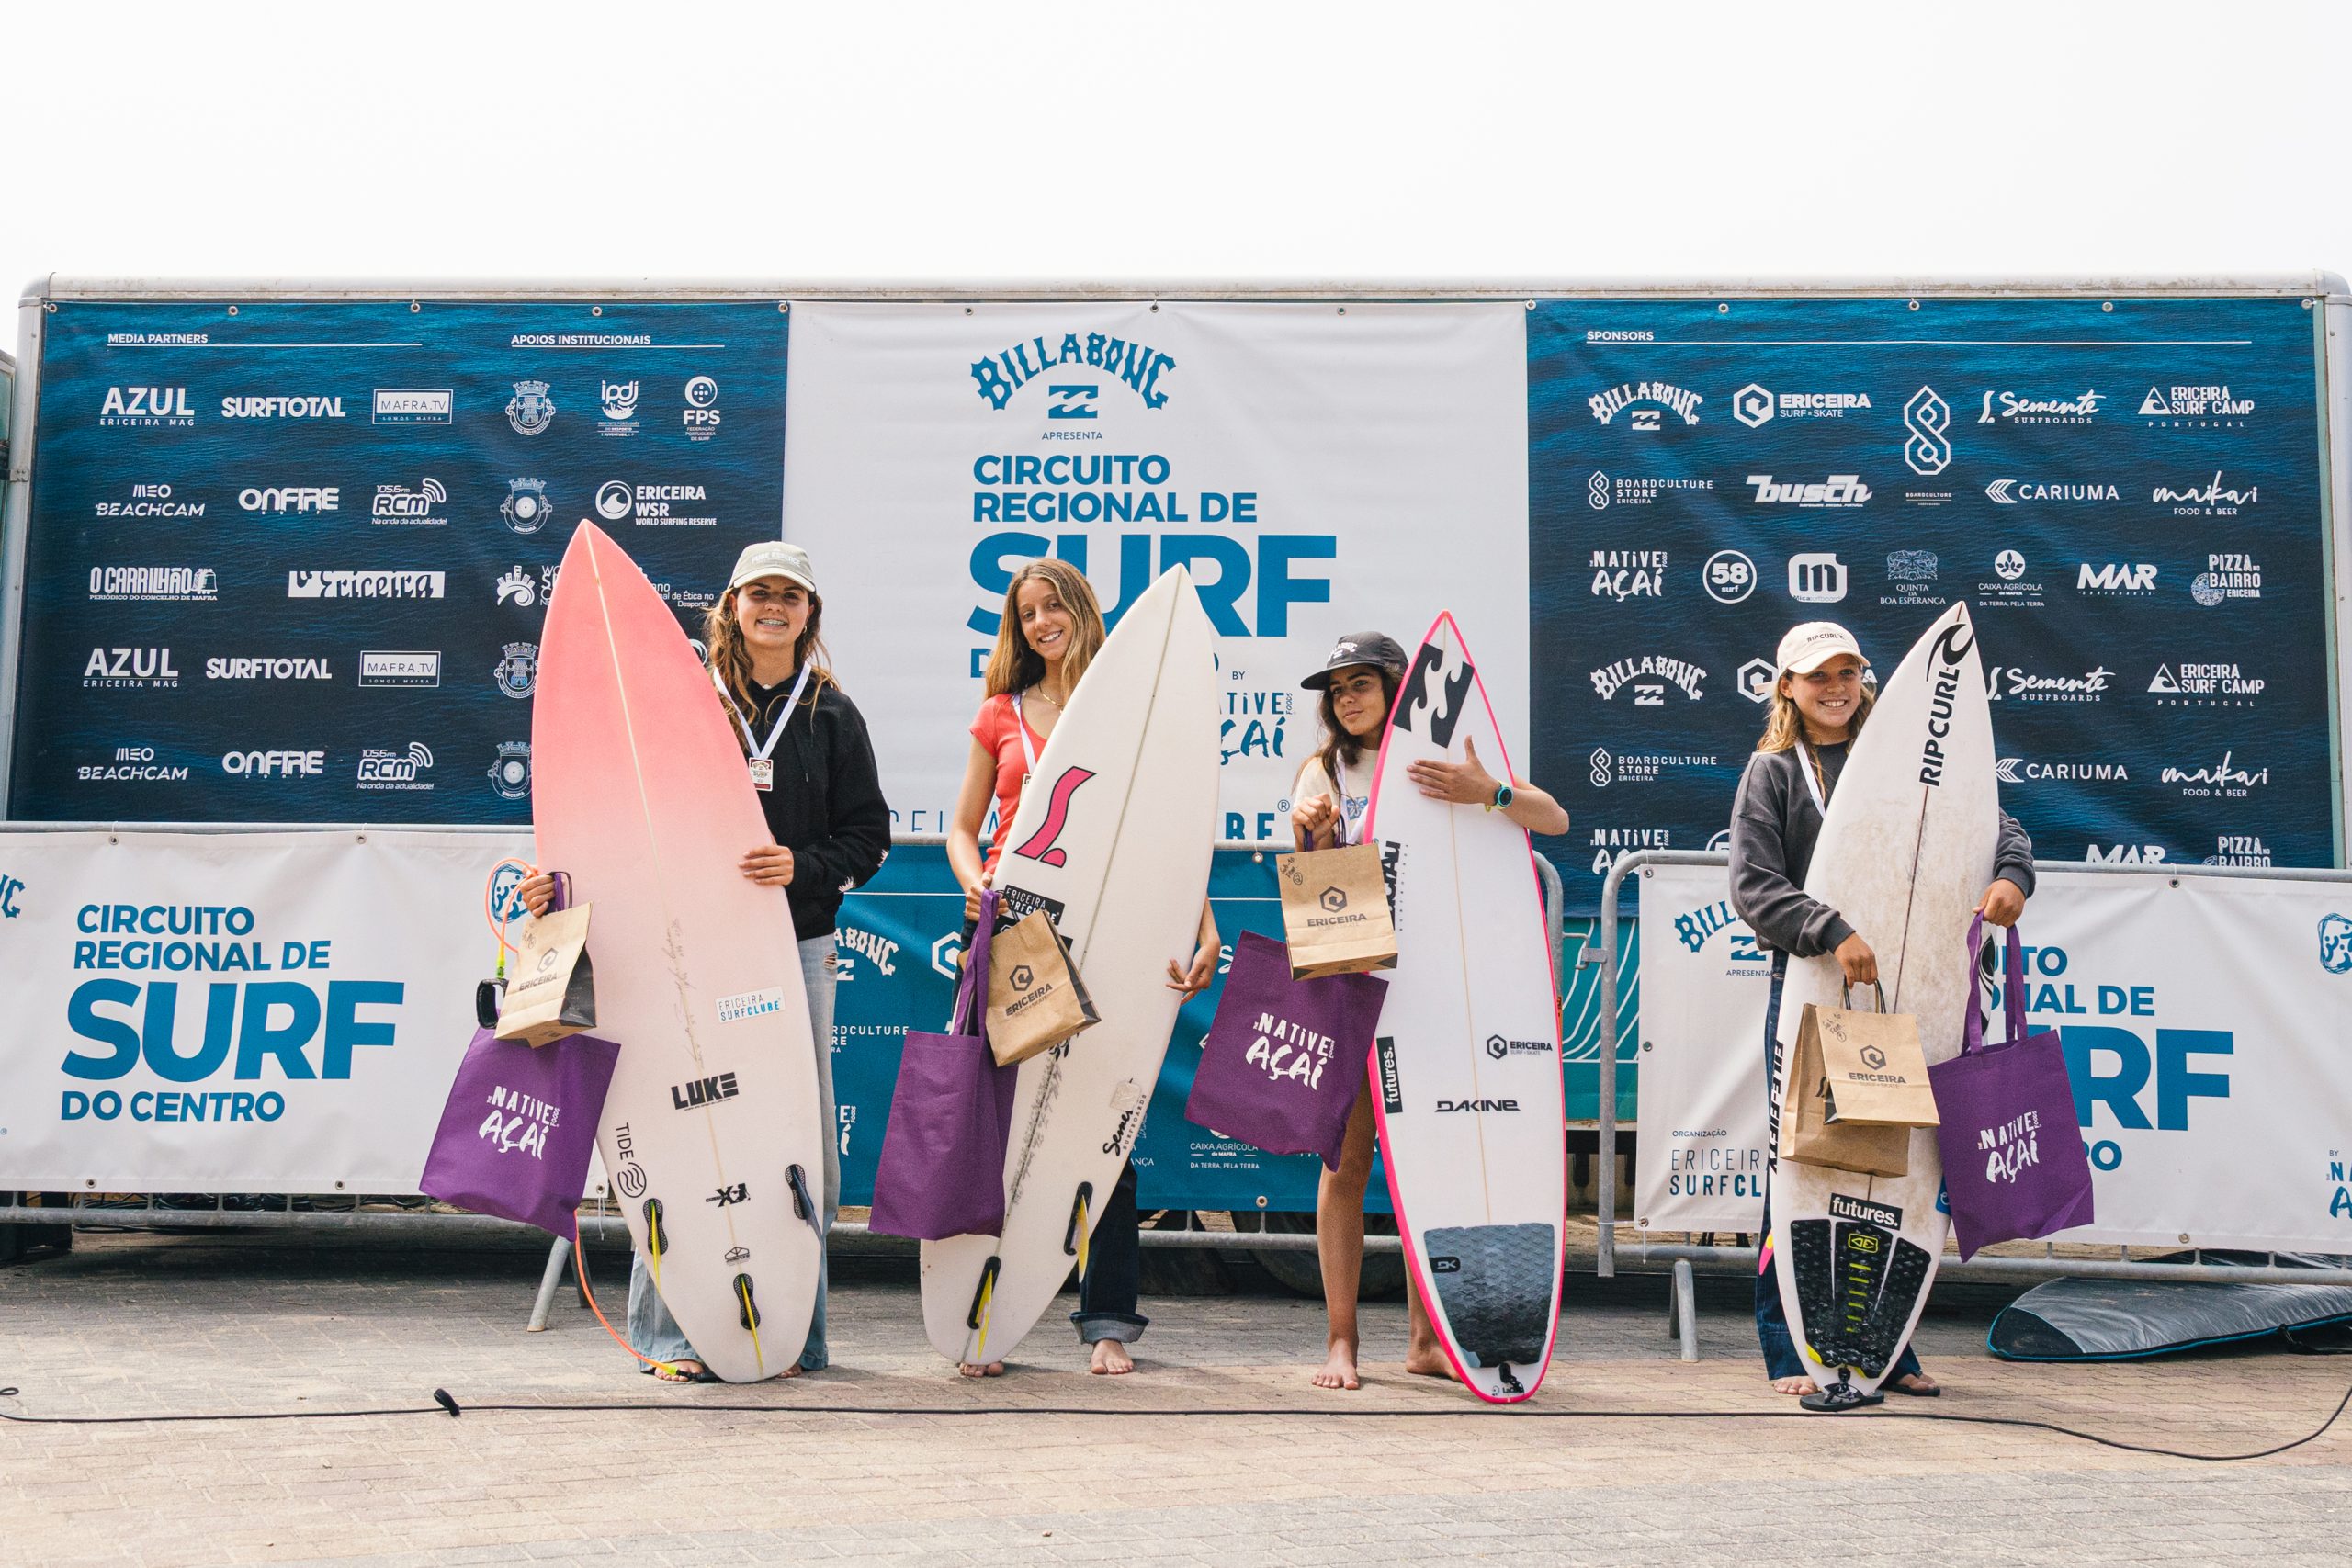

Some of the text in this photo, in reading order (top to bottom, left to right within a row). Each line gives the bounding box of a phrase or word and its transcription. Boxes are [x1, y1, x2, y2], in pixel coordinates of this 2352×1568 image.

[107, 333, 209, 344] MEDIA PARTNERS
[511, 334, 651, 345] APOIOS INSTITUCIONAIS
[1587, 331, 1655, 341] SPONSORS
[970, 331, 1177, 411] BILLABONG
[101, 387, 195, 415] AZUL
[1779, 393, 1872, 408] ERICEIRA
[2171, 386, 2231, 400] ERICEIRA
[221, 397, 346, 419] SURFTOTAL
[1588, 380, 1703, 426] BILLABONG
[1999, 389, 2107, 416] Semente
[2172, 400, 2255, 415] SURF CAMP
[99, 418, 195, 426] ERICEIRA MAG
[684, 410, 721, 425] FPS
[1780, 409, 1843, 417] SURF SKATE
[1042, 432, 1102, 441] APRESENTA
[973, 454, 1170, 485] CIRCUITO
[636, 485, 706, 501] ERICEIRA
[1617, 479, 1713, 489] BOARDCULTURE
[1746, 474, 1873, 503] busch
[2019, 483, 2120, 500] CARIUMA
[1617, 489, 1657, 498] STORE
[635, 502, 669, 516] WSR
[974, 492, 1258, 523] REGIONAL DE
[635, 518, 718, 526] WORLD SURFING RESERVE
[2209, 554, 2253, 571] PIZZA
[90, 566, 103, 593] O
[1711, 562, 1748, 585] 58
[2076, 563, 2159, 590] MAR
[2209, 573, 2261, 588] BAIRRO
[967, 532, 1337, 637] SURF
[1721, 584, 1739, 593] surf
[1896, 584, 1929, 592] QUINTA
[2003, 581, 2043, 591] AGRÍCOLA
[1898, 597, 1946, 606] ESPERANÇA
[85, 649, 179, 677] AZUL
[206, 658, 333, 680] SURFTOTAL
[2180, 663, 2240, 680] ERICEIRA
[1232, 671, 1246, 680] BY
[1589, 654, 1708, 702] BILLABONG
[2007, 665, 2117, 694] Semente
[2181, 680, 2265, 694] SURF CAMP
[1929, 668, 1960, 739] CURL
[1220, 716, 1286, 766] ÇAÍ
[1619, 755, 1717, 765] BOARDCULTURE
[1918, 739, 1949, 787] RIP
[1619, 765, 1659, 775] STORE
[2025, 762, 2128, 781] CARIUMA
[2183, 788, 2247, 797] FOOD & BEER
[2218, 836, 2262, 854] PIZZA
[2086, 844, 2166, 865] MAR
[77, 904, 255, 935] CIRCUITO
[1306, 913, 1368, 927] ERICEIRA
[74, 940, 332, 972] REGIONAL DE
[518, 971, 559, 992] ERICEIRA
[1725, 969, 1771, 977] APRESENTA
[718, 994, 764, 1010] ERICEIRA
[1005, 983, 1054, 1017] ERICEIRA
[2098, 985, 2155, 1016] DE
[720, 1000, 779, 1021] SURFCLUBE
[61, 978, 405, 1083] SURF
[1510, 1040, 1553, 1051] ERICEIRA
[1385, 1046, 1400, 1104] futures.
[1849, 1071, 1907, 1084] ERICEIRA
[671, 1071, 739, 1111] LUKE
[61, 1089, 286, 1122] DO CENTRO
[1434, 1100, 1521, 1113] DAKINE
[1123, 1095, 1147, 1150] SURFBOARDS
[616, 1122, 634, 1160] TIDE
[1672, 1128, 1727, 1139] ORGANIZAÇÃO
[1671, 1148, 1764, 1172] ERICEIR
[1669, 1175, 1762, 1198] SURFCL
[1832, 1197, 1899, 1227] futures.
